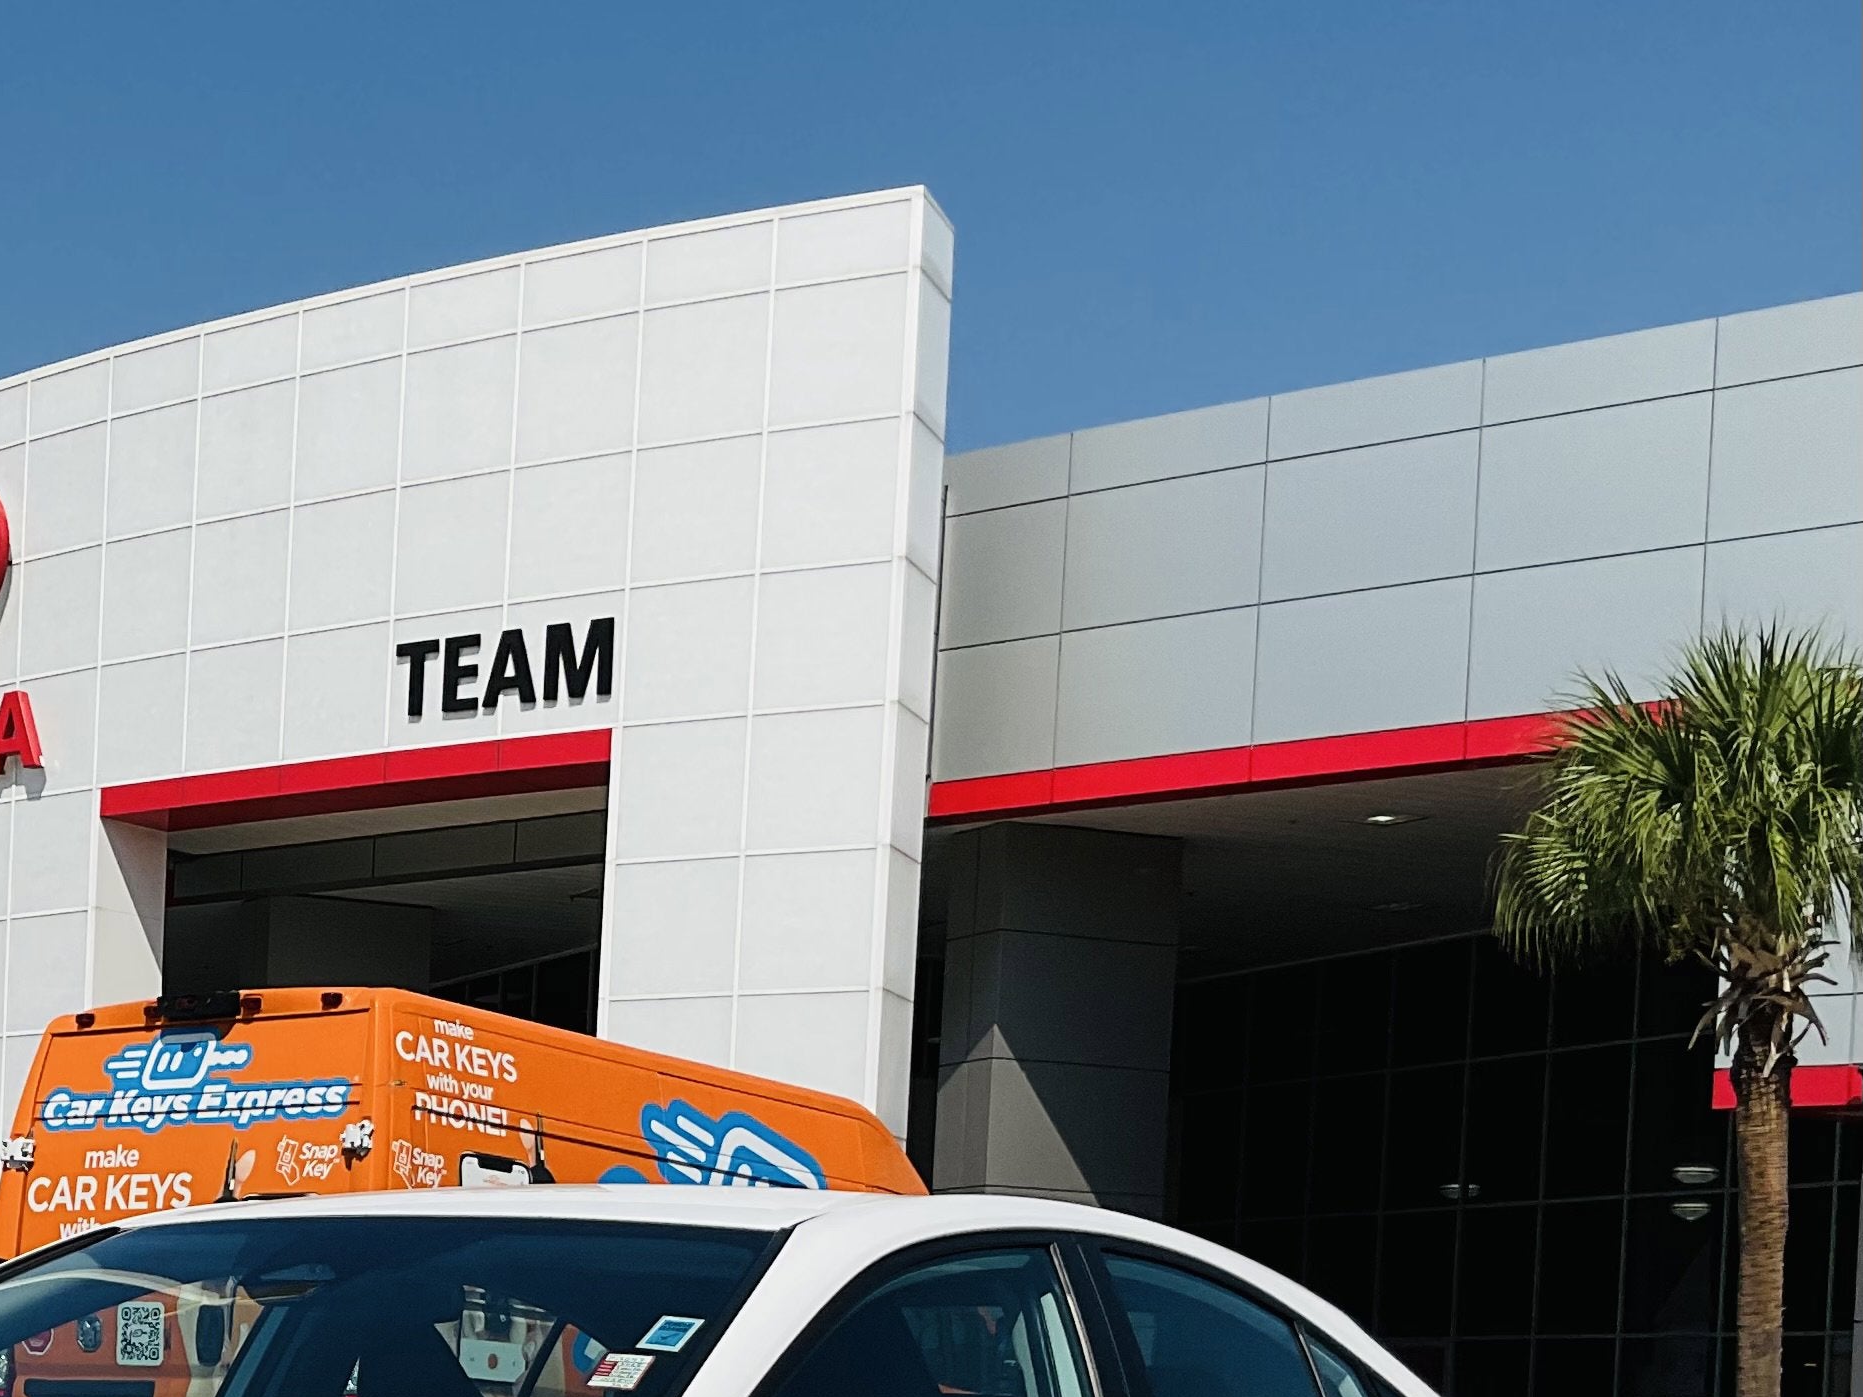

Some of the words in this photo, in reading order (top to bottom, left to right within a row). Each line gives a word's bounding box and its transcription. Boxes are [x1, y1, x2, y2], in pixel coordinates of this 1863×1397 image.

[397, 617, 615, 718] TEAM
[434, 1019, 475, 1041] make
[395, 1030, 451, 1069] CAR
[454, 1042, 518, 1083] KEYS
[426, 1072, 459, 1095] with
[461, 1080, 494, 1101] your
[43, 1092, 105, 1127] Car
[107, 1089, 192, 1129] Keys
[196, 1084, 347, 1124] Express
[415, 1092, 508, 1137] PHONE!
[84, 1144, 140, 1169] make
[299, 1142, 339, 1161] Snap
[412, 1147, 445, 1169] Snap
[27, 1174, 98, 1213] CAR
[104, 1172, 193, 1210] KEYS
